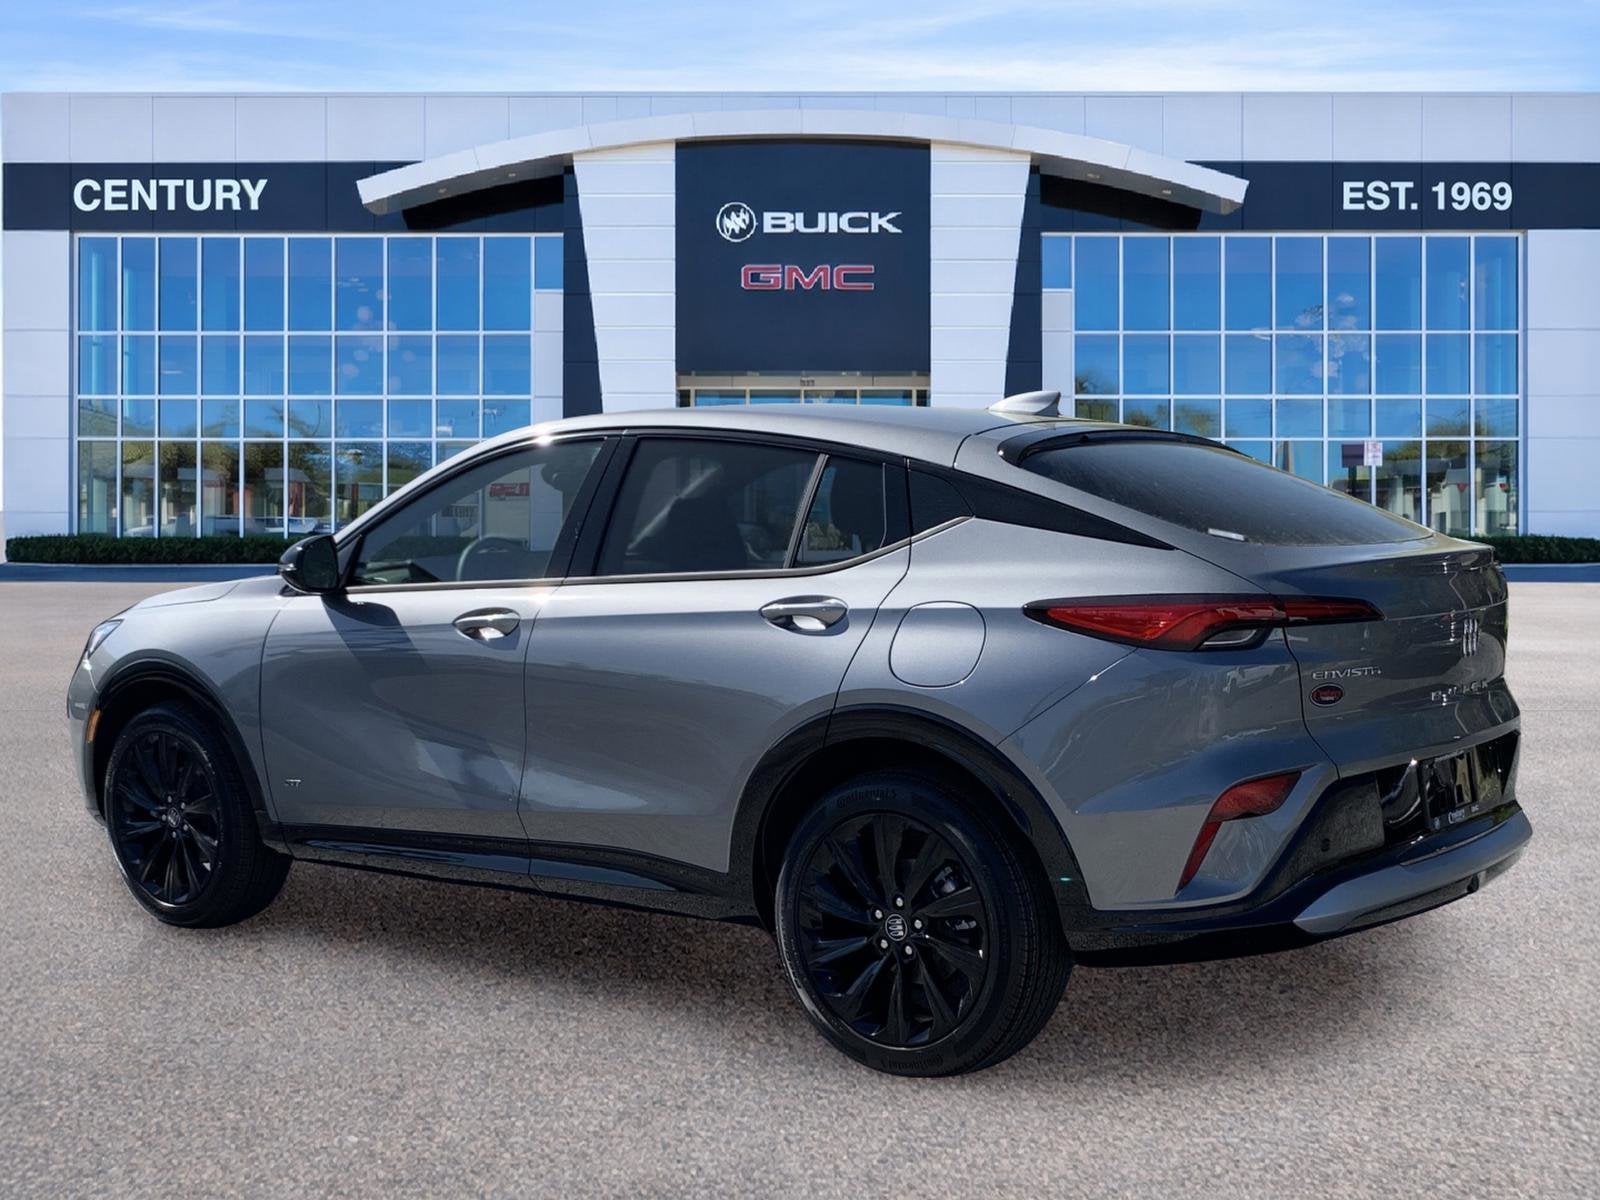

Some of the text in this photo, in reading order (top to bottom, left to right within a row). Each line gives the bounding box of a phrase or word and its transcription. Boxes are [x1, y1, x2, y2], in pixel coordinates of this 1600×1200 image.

[73, 178, 268, 212] CENTURY
[1342, 180, 1513, 211] EST. 1969
[763, 211, 903, 234] BUICK
[741, 264, 875, 291] GMC
